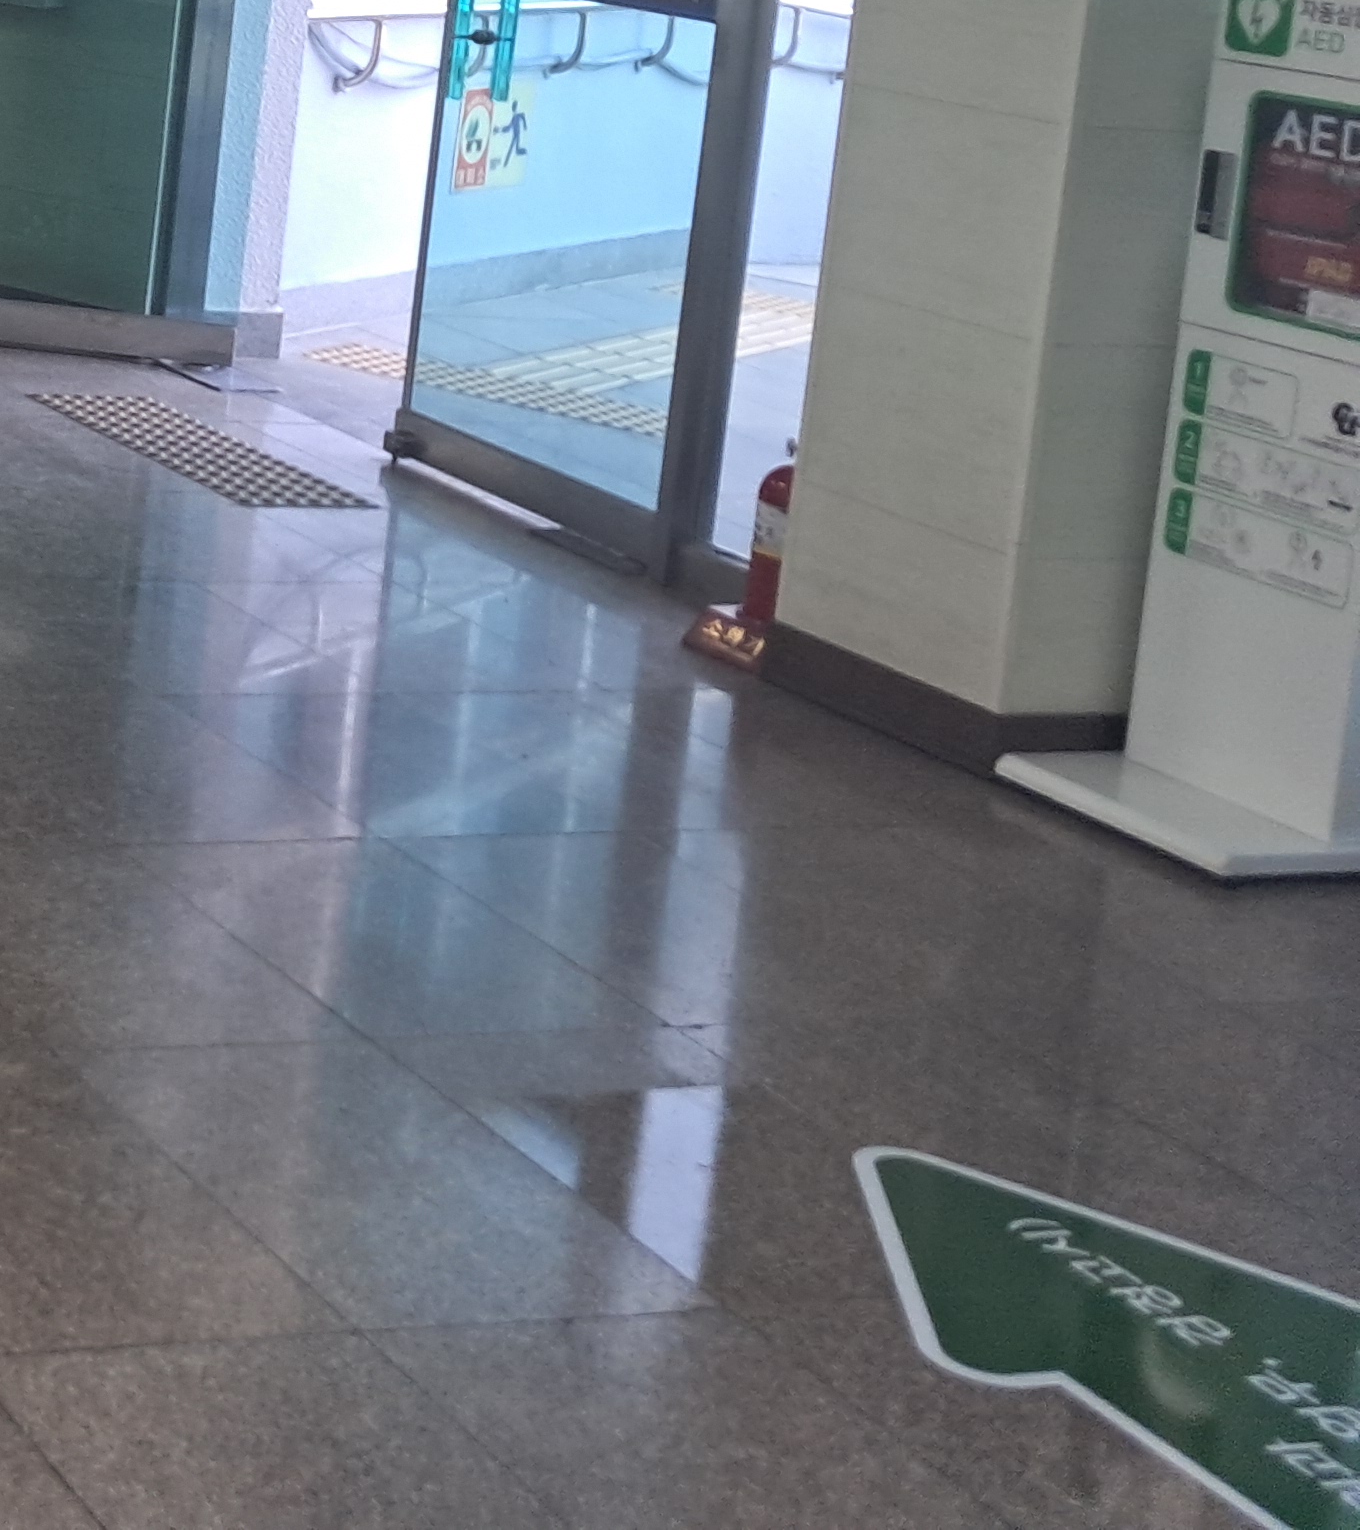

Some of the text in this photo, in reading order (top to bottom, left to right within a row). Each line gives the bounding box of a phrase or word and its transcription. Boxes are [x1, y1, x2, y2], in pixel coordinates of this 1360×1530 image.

[1296, 27, 1345, 54] AED
[1272, 109, 1360, 162] AED
[1186, 431, 1198, 449] 2
